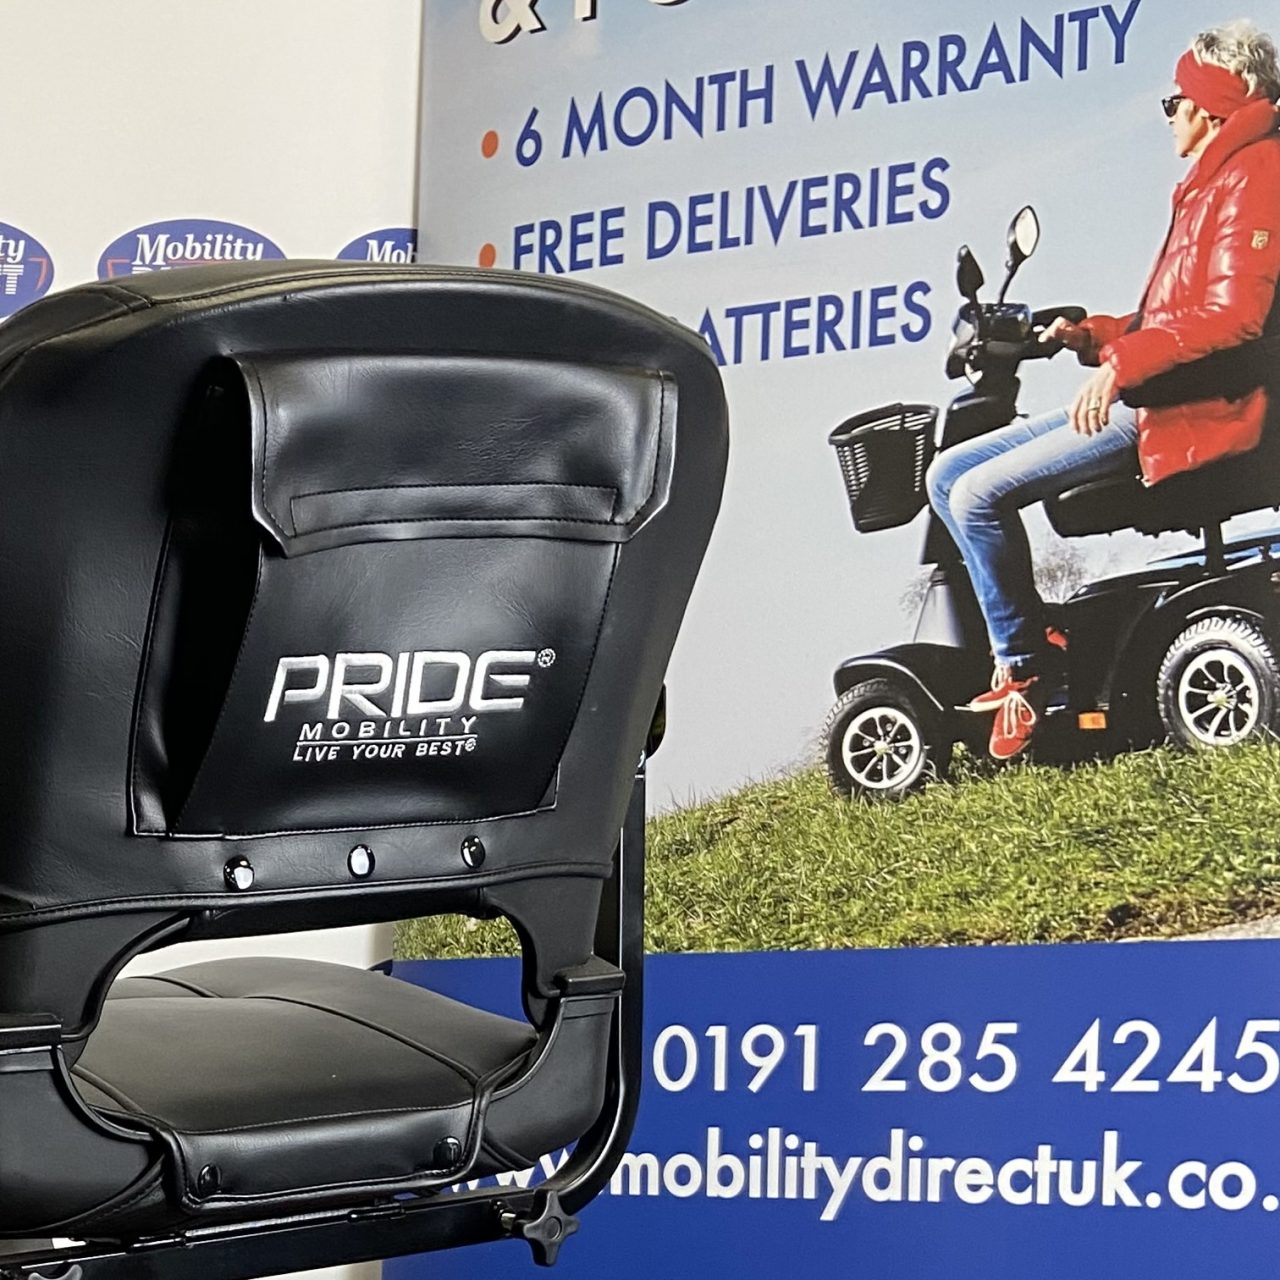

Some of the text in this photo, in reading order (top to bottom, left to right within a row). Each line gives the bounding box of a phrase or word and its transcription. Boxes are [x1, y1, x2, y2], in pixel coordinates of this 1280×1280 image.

[515, 0, 1141, 167] 6 MONTH WARRANTY
[131, 233, 264, 266] Mobility
[513, 157, 951, 275] FREE DELIVERIES
[697, 281, 932, 368] ATTERIES
[292, 745, 337, 762] LIVE
[352, 743, 403, 760] YOUR
[299, 716, 478, 741] MOBILITY
[652, 1016, 1280, 1093] 0191 285 4245
[451, 1126, 1280, 1222] mobilitydirectuk.co.
